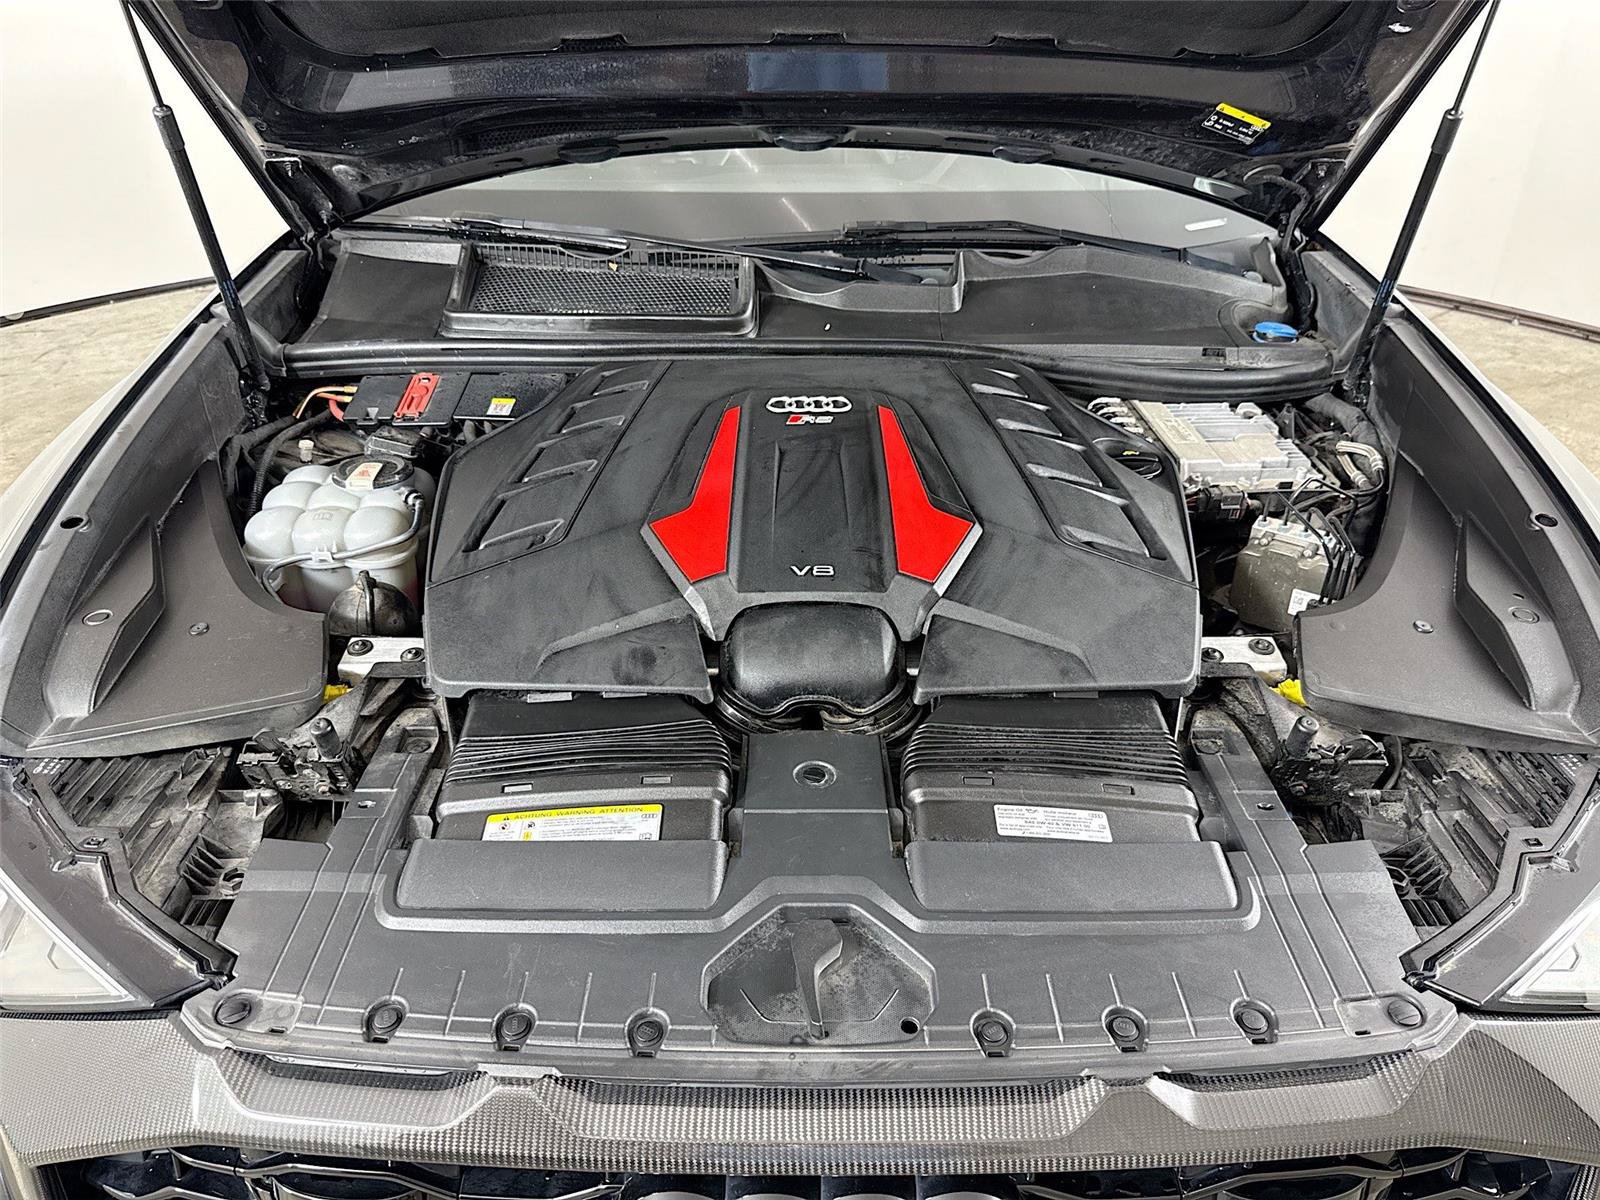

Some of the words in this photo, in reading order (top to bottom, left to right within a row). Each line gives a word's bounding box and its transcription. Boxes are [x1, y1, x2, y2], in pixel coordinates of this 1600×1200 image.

[790, 565, 834, 576] V8
[514, 812, 553, 820] ACHTUNG
[600, 806, 644, 814] ATTENTION
